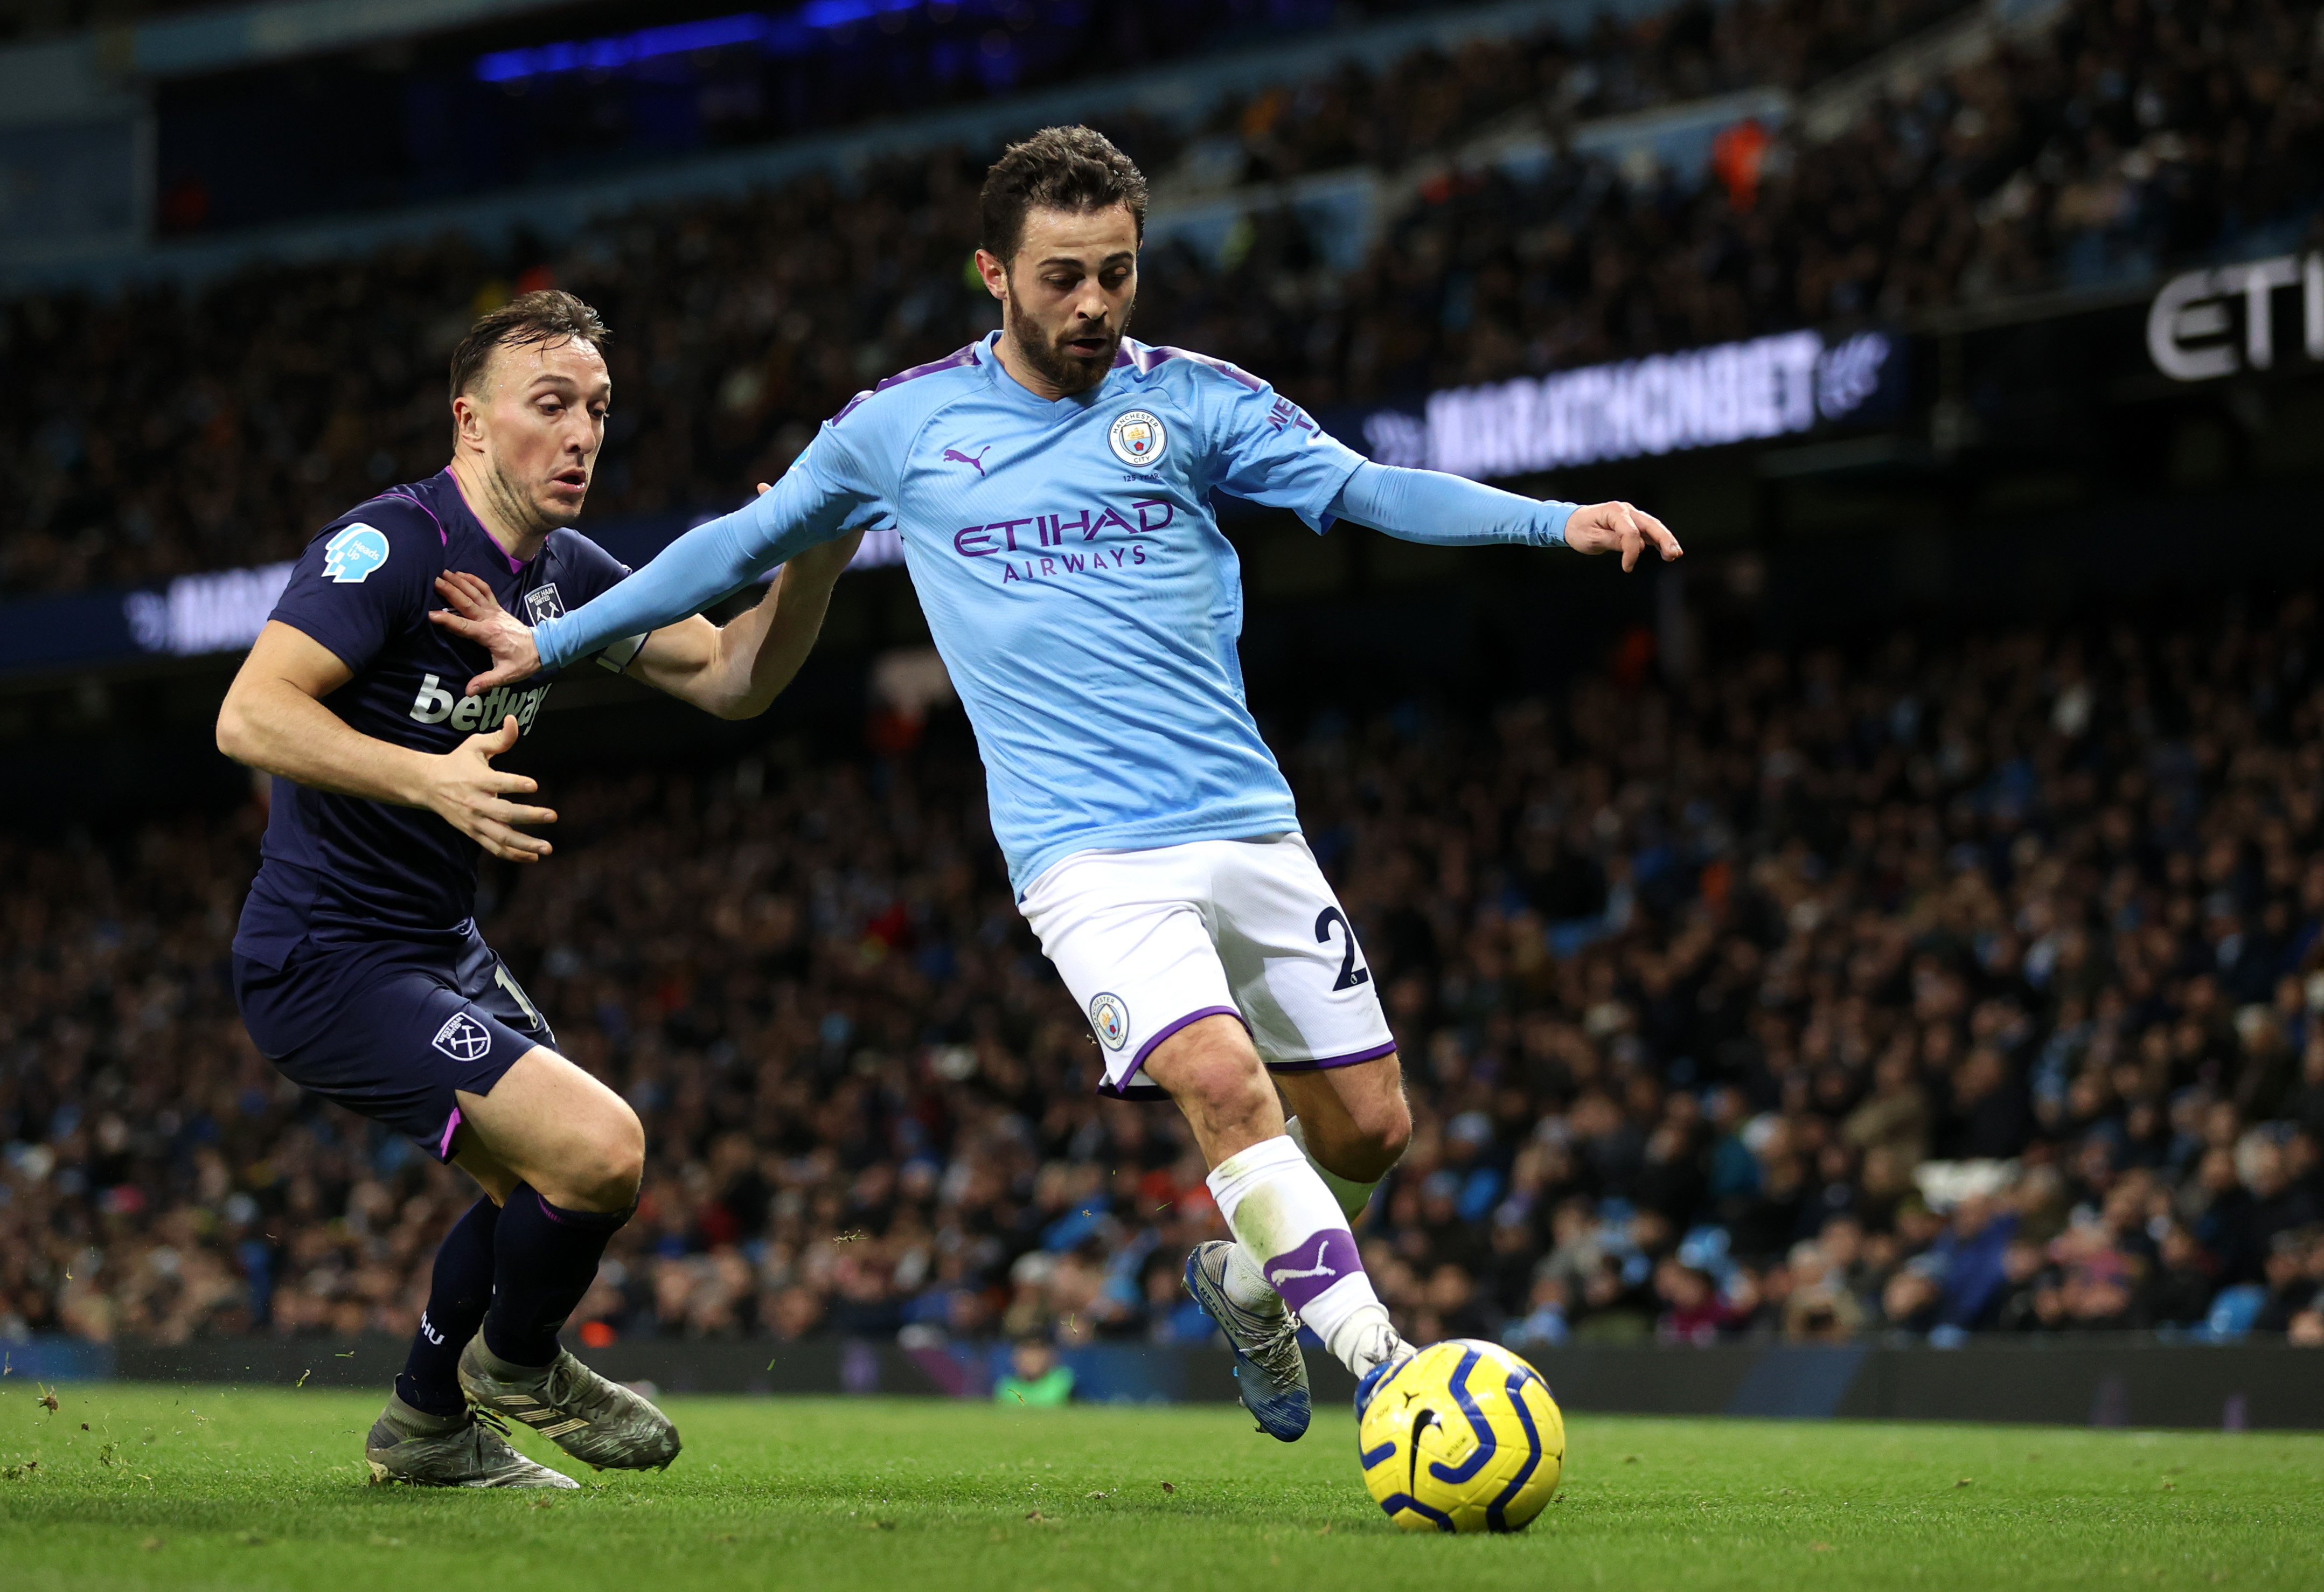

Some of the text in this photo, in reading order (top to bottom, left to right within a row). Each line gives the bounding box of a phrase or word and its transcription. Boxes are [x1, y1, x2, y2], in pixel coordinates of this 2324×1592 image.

[1113, 413, 1158, 434] MANCHESTER
[955, 499, 1173, 557] ETIHAD
[347, 547, 360, 560] Up
[351, 540, 380, 560] Heads
[1003, 545, 1146, 583] AIRWAYS
[528, 587, 554, 603] WEST HAM
[534, 595, 551, 606] UNITED
[409, 673, 552, 736] betway
[437, 1016, 464, 1043] WEST HAM
[446, 1022, 462, 1039] UNITED
[1116, 1032, 1124, 1046] CITY
[421, 1310, 445, 1345] HU
